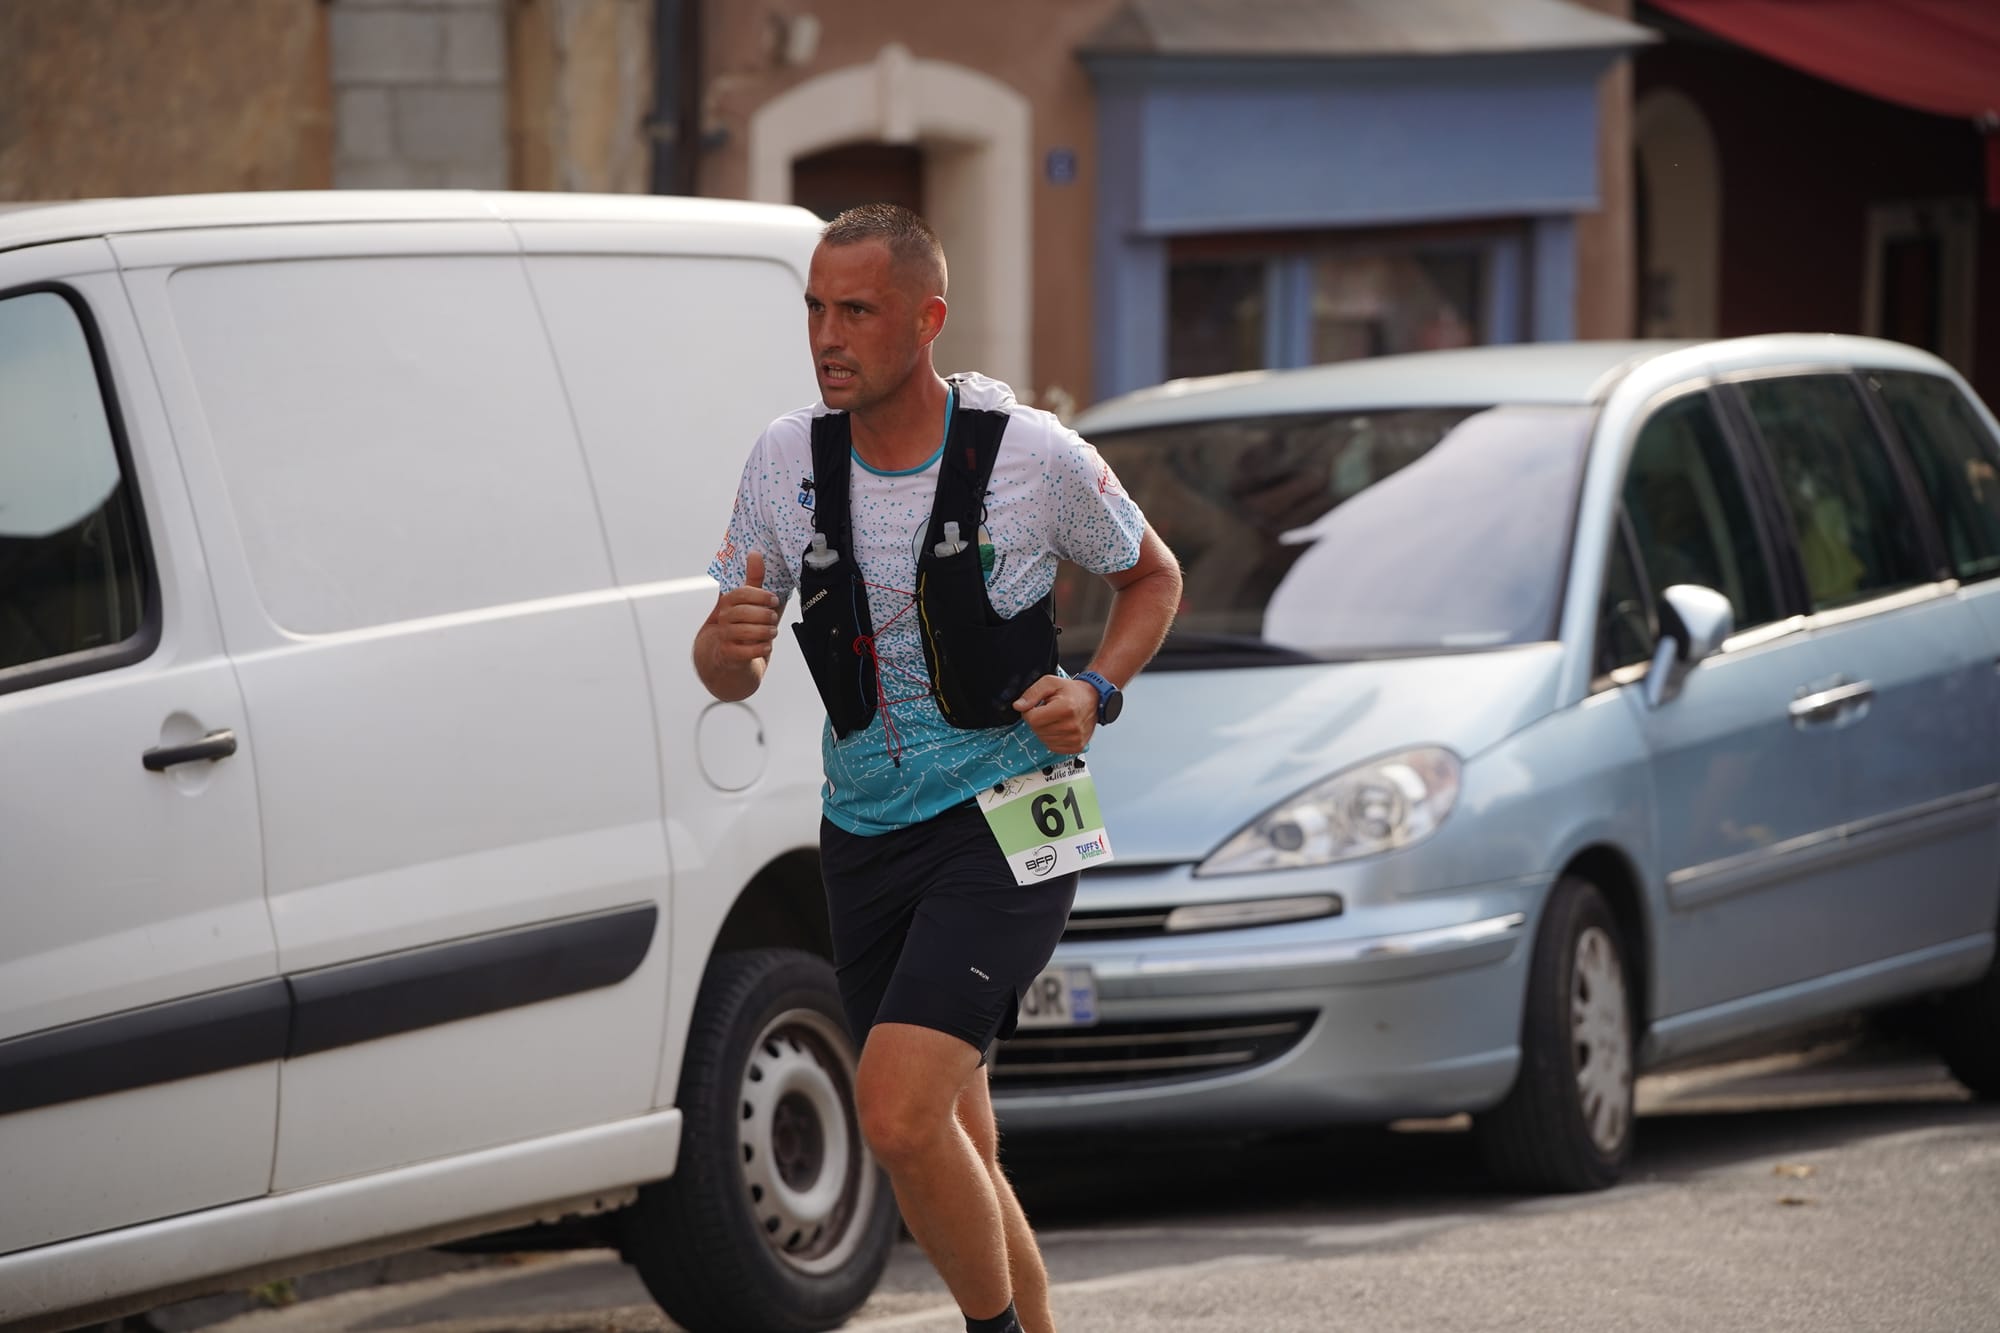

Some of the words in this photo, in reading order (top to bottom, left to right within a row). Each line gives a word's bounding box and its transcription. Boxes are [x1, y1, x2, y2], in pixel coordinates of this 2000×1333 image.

[801, 589, 828, 613] LOMON
[1031, 786, 1084, 838] 61
[1025, 854, 1053, 870] BFP
